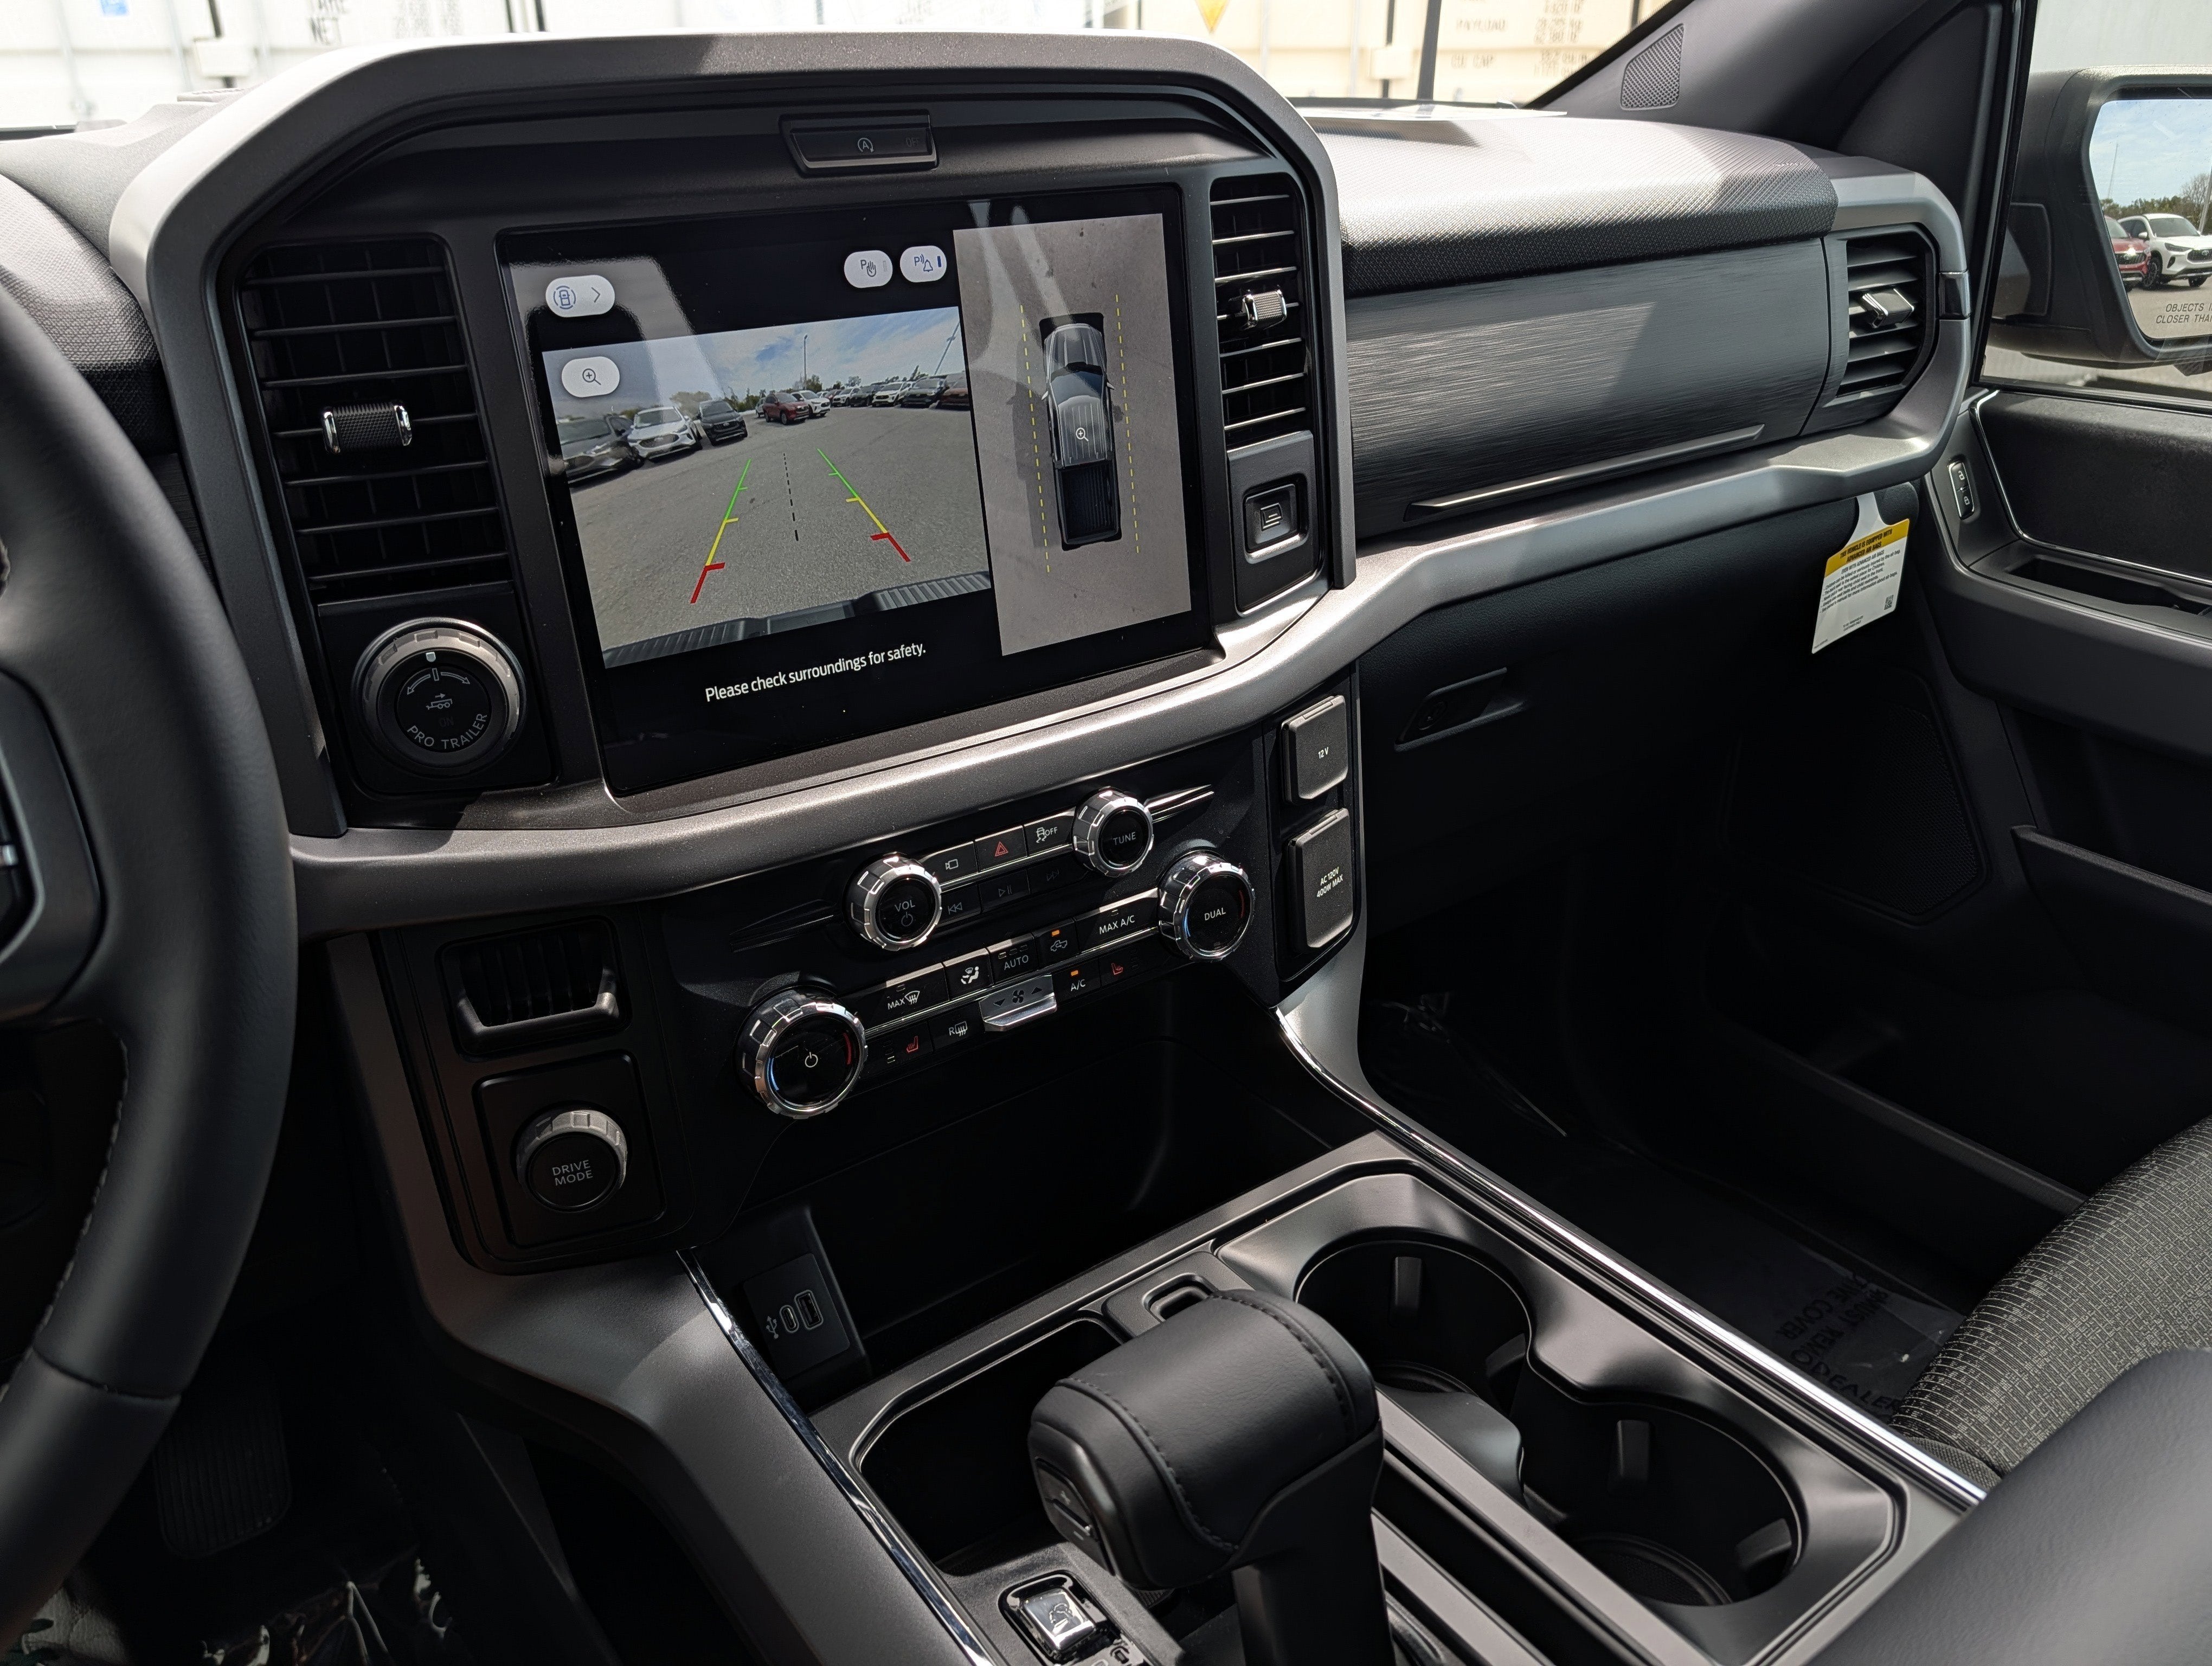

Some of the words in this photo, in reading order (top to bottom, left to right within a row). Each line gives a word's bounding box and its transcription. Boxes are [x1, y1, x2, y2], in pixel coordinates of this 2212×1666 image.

[2165, 303, 2204, 312] OBJECTS
[2208, 303, 2212, 311] I
[2156, 315, 2190, 324] CLOSER
[1847, 542, 1861, 554] VEHICLE
[1866, 533, 1883, 544] EQUIPPED
[1883, 528, 1893, 537] WITH
[1846, 549, 1865, 563] ADVANCED
[1872, 541, 1882, 551] BAGS
[705, 682, 749, 702] Please
[751, 672, 787, 691] check
[788, 656, 867, 683] surroundings
[868, 651, 885, 665] for
[887, 643, 926, 661] safety.
[407, 725, 434, 747] PRO
[441, 714, 487, 749] TRAILER
[1044, 826, 1058, 836] OFF
[1113, 831, 1137, 845] TUNE
[1320, 875, 1327, 886] AC
[1327, 867, 1339, 880] 120V
[1317, 882, 1331, 898] 400W
[1332, 874, 1343, 887] MAX
[894, 899, 915, 912] VOL
[1204, 907, 1226, 921] DUAL
[1099, 921, 1118, 934] MAX
[1121, 914, 1135, 928] A/C
[1004, 954, 1029, 971] AUTO
[1070, 979, 1086, 992] A/C
[888, 997, 906, 1010] MAX
[949, 1027, 955, 1036] R
[552, 1159, 590, 1176] DRIVE
[555, 1170, 593, 1186] MODE
